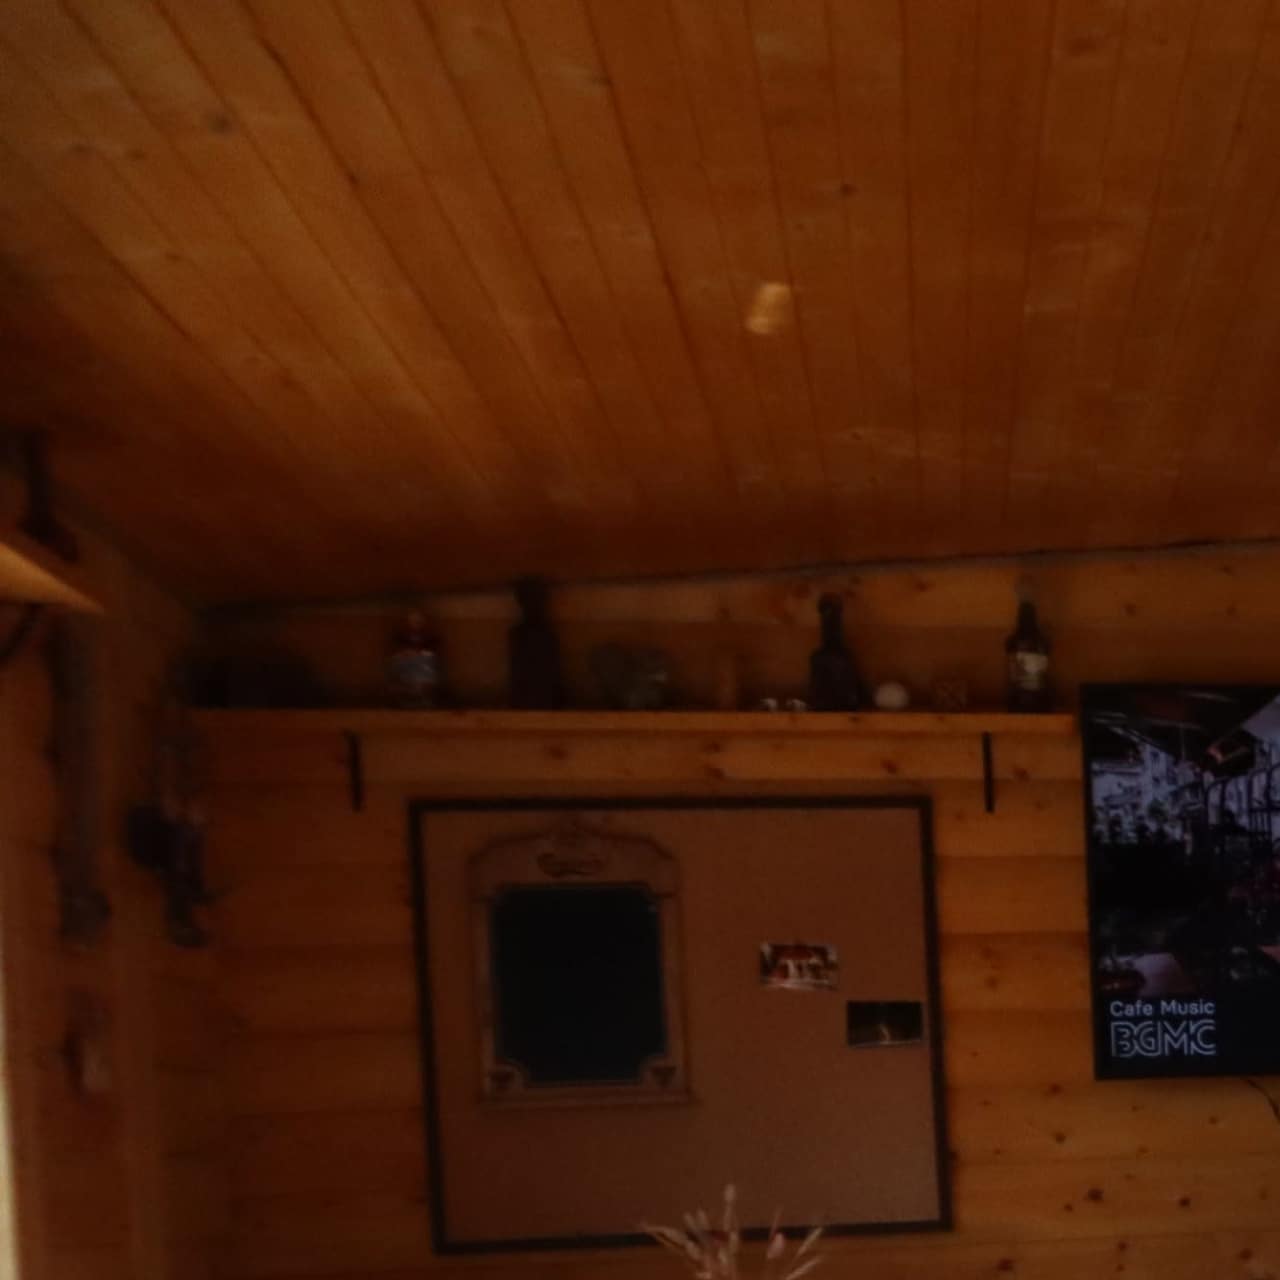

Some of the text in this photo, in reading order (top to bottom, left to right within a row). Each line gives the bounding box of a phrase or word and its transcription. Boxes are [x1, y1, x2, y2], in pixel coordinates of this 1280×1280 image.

[1110, 998, 1215, 1017] Cafe Music
[1111, 1019, 1217, 1058] BGMC
